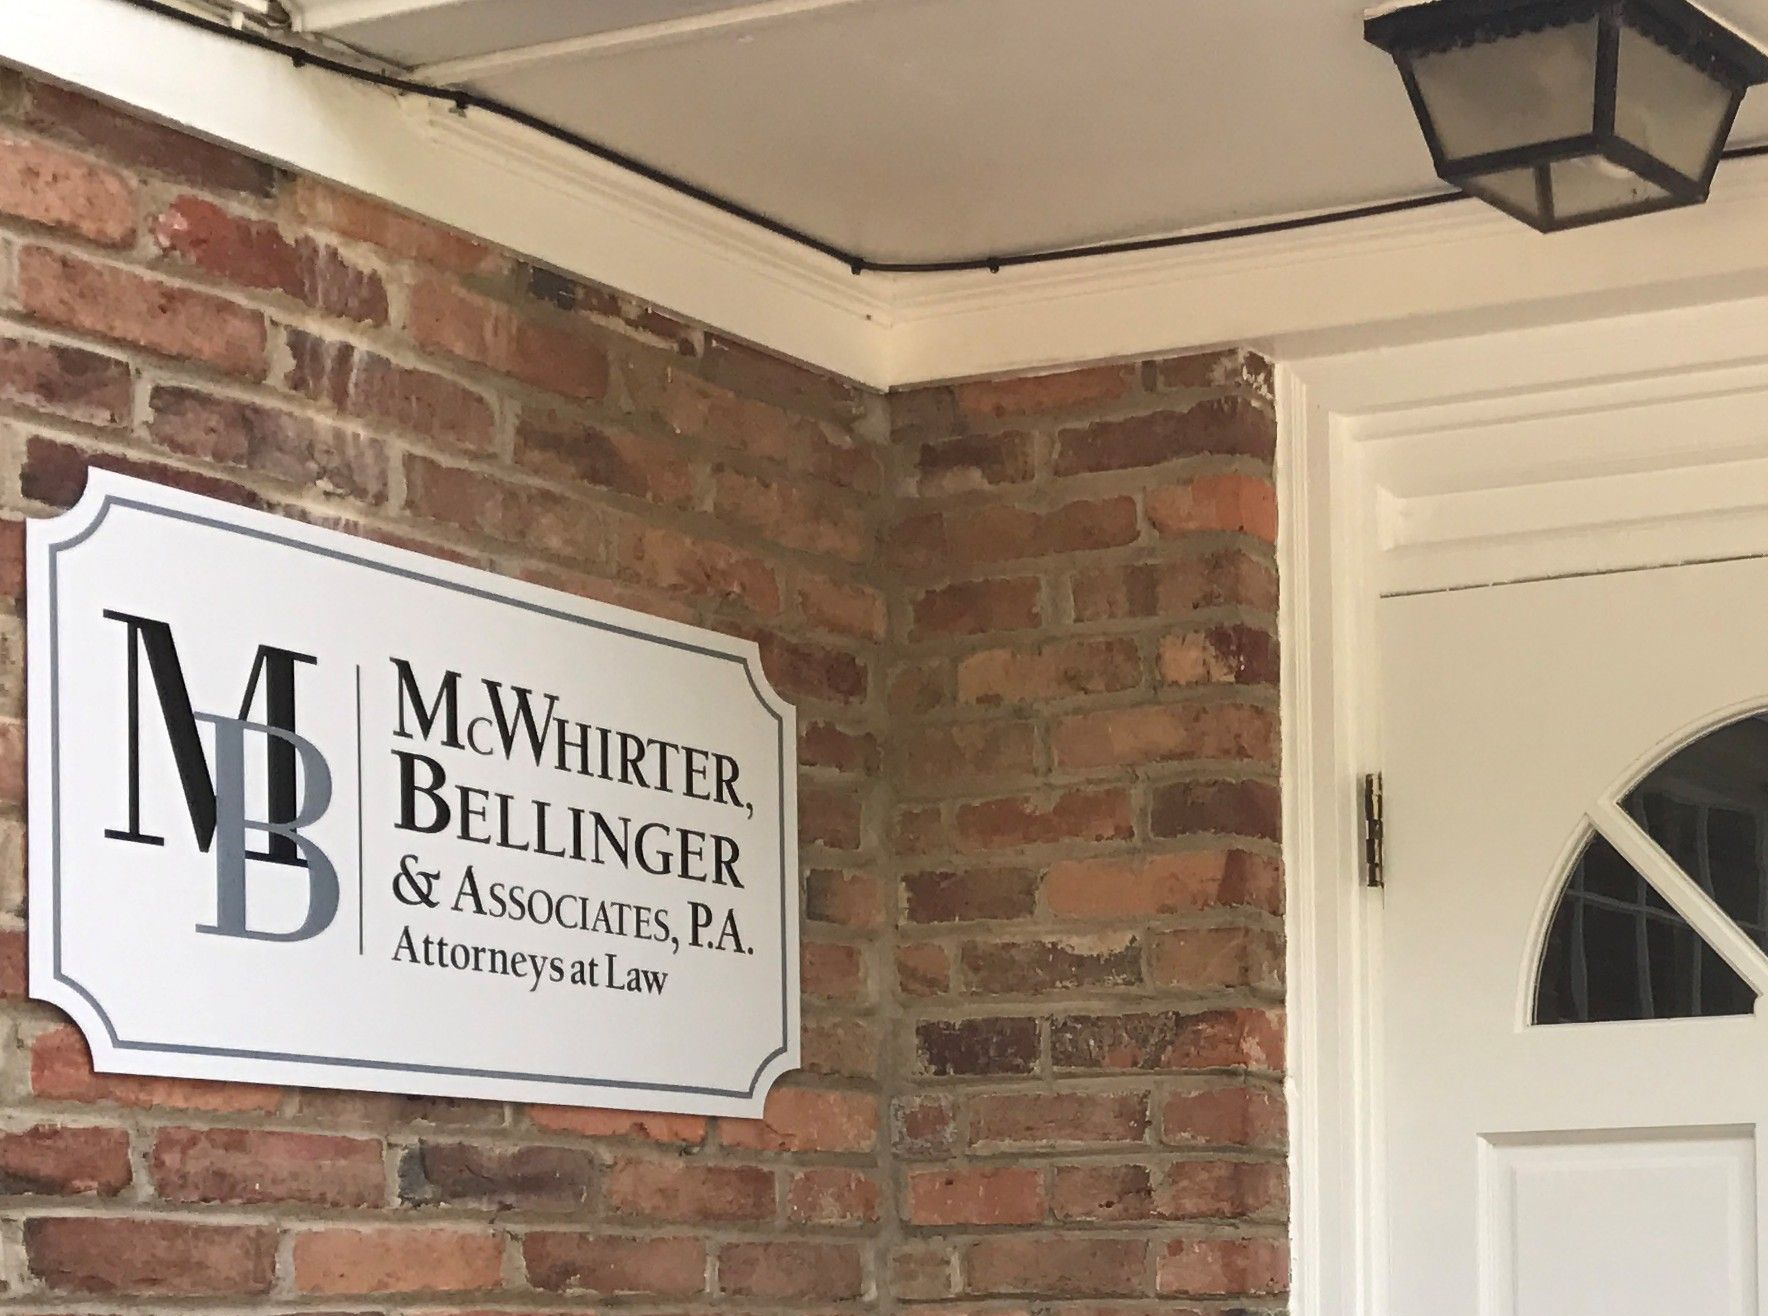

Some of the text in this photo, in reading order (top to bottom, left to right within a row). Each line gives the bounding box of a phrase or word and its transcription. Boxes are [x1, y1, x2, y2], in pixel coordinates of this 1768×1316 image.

[390, 748, 746, 890] BELLINGER
[391, 854, 755, 956] & ASSOCIATES, P.A.
[391, 924, 669, 996] Attorneys at Law
